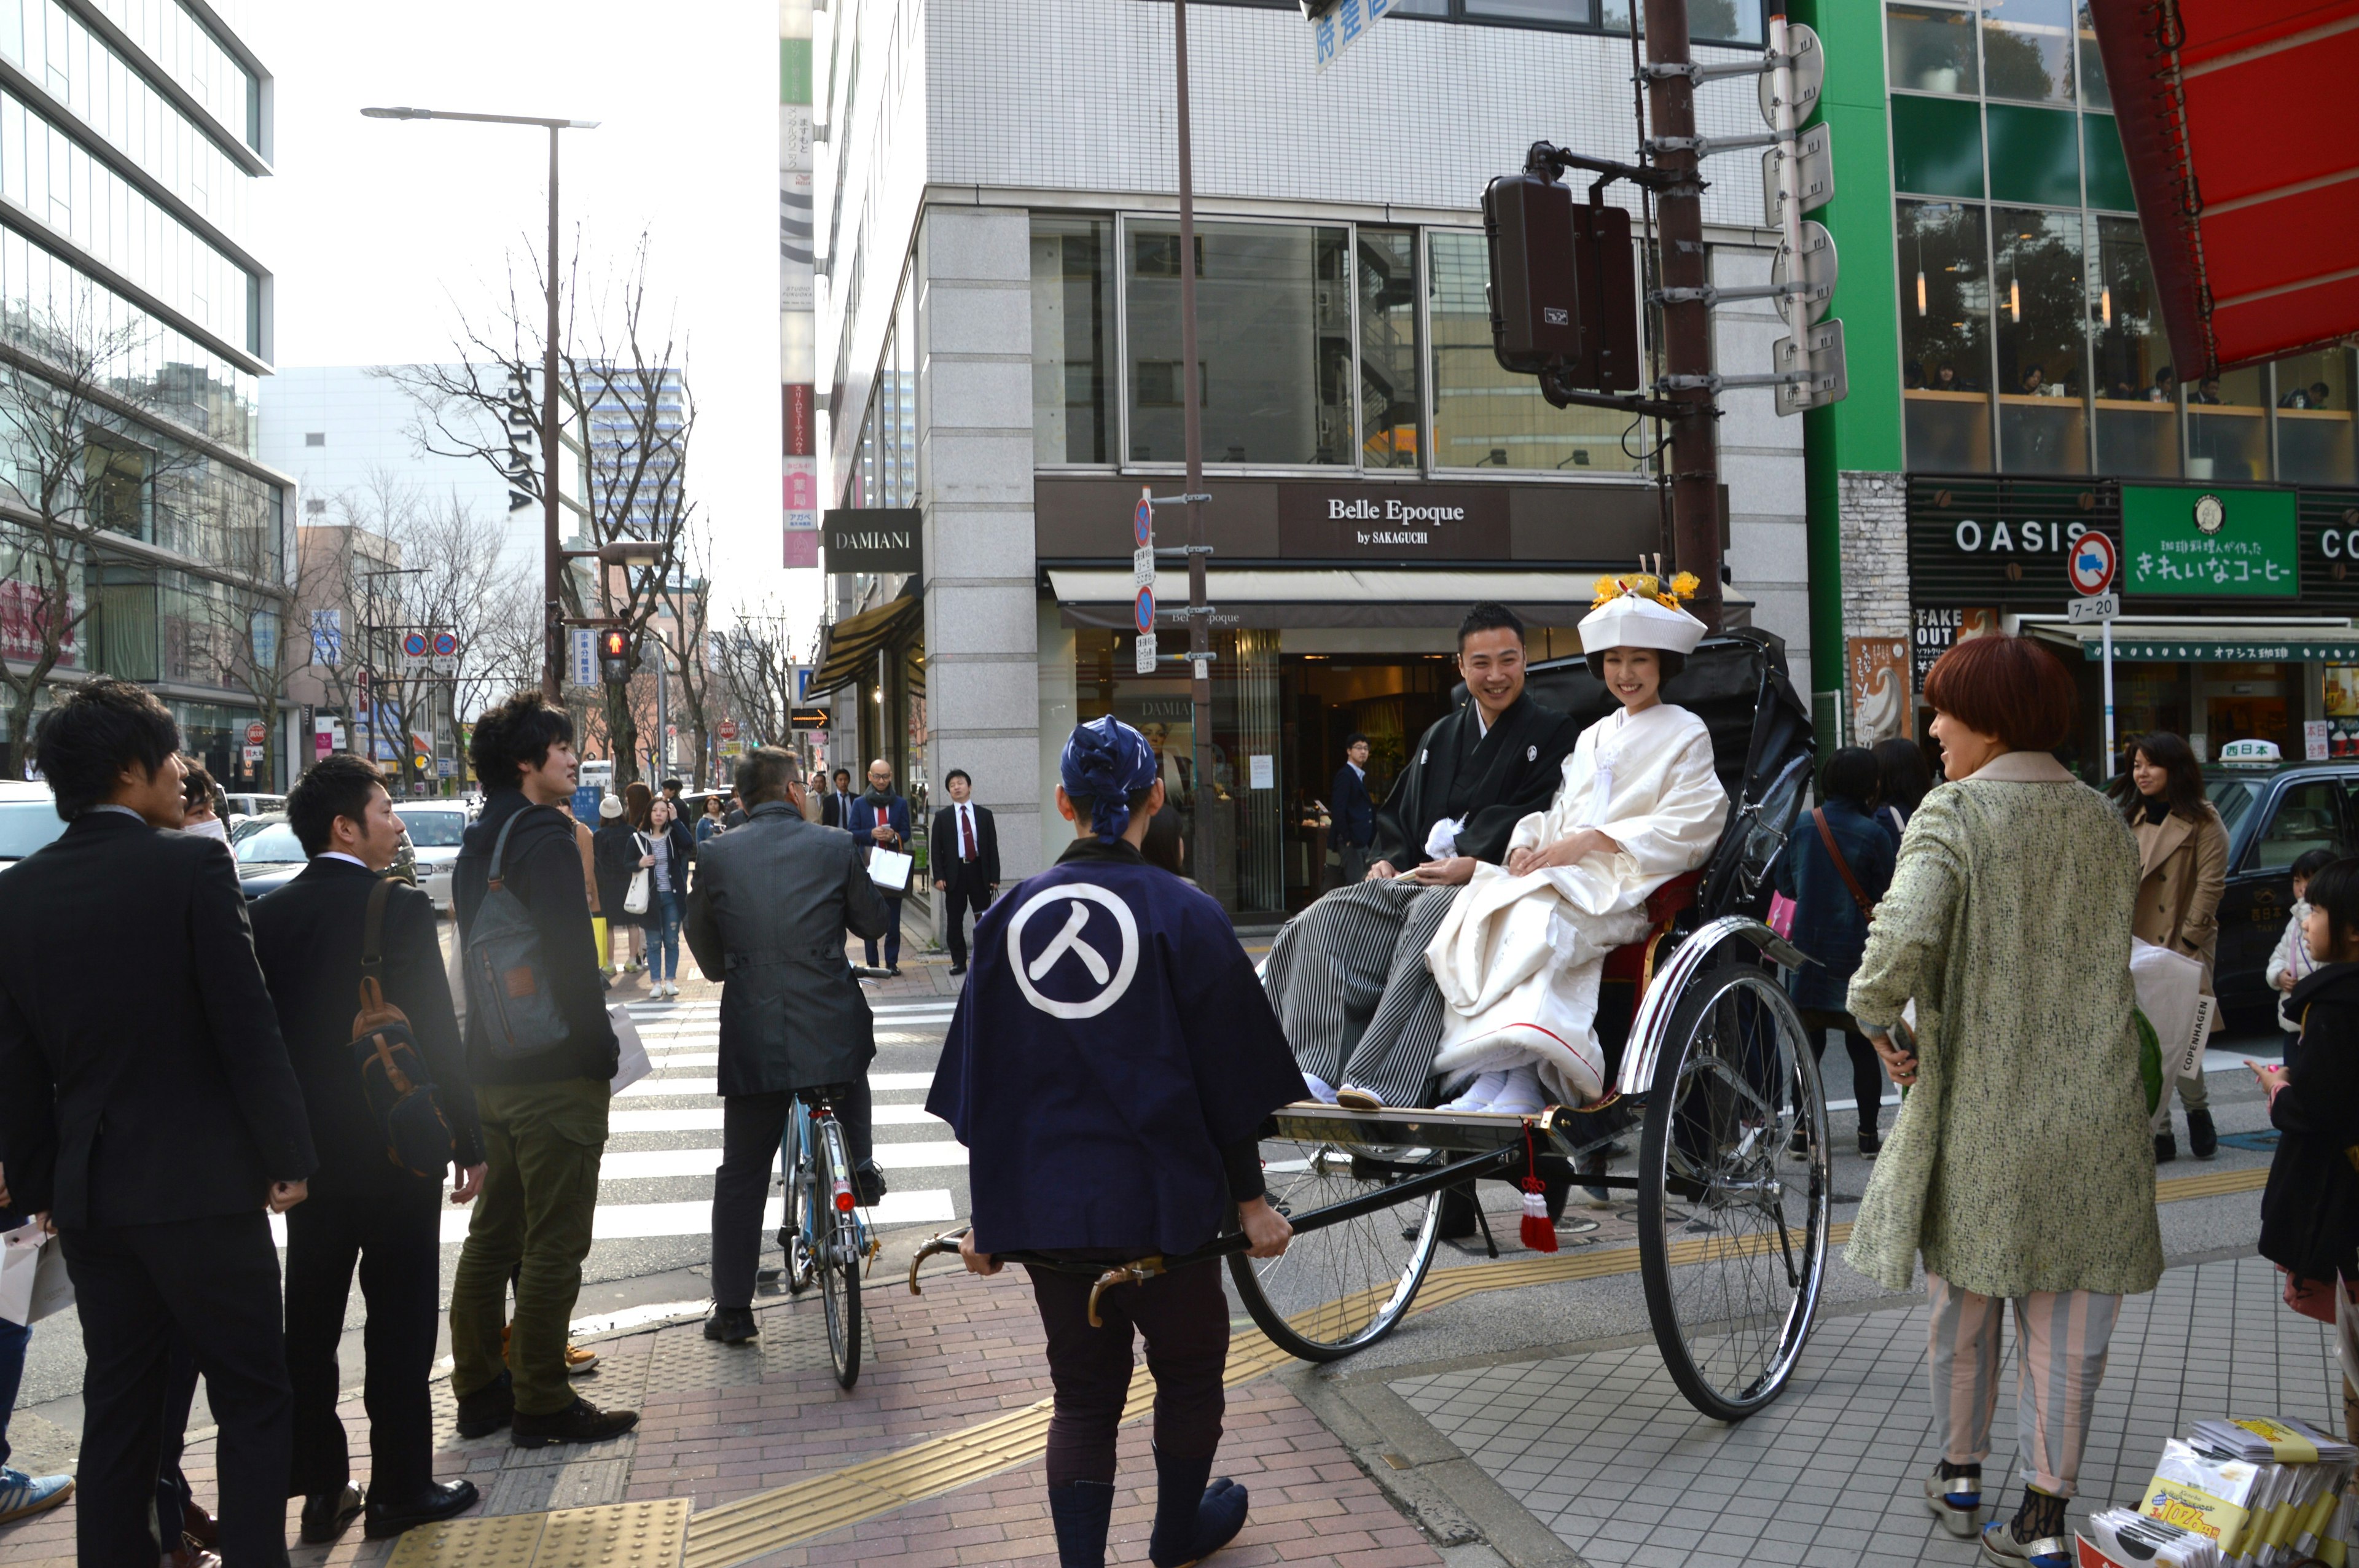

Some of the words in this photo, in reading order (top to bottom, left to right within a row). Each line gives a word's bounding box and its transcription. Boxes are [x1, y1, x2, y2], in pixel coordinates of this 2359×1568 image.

[508, 367, 532, 512] TSUTAYA
[794, 478, 806, 507] 薬局
[1328, 499, 1380, 520] Belle
[1385, 500, 1464, 526] Epoque
[836, 532, 910, 548] DAMIANI
[1357, 531, 1370, 545] by
[1372, 532, 1428, 544] SAKAGUCHI
[1956, 520, 2087, 552] OASIS
[2161, 539, 2261, 555] 珈琲料理人が作った
[2137, 552, 2290, 583] きれいなコーヒー
[2075, 600, 2111, 617] 7-20
[1207, 615, 1239, 625] poque
[1916, 609, 1962, 626] TAKE
[1917, 628, 1951, 645] OUT
[581, 633, 589, 683] 歩車分離信号
[2215, 647, 2288, 658] オアシス珈琲
[2307, 725, 2326, 736] 本日
[2226, 744, 2268, 756] 西日本
[2308, 744, 2326, 757] 全席
[2183, 1001, 2207, 1071] COPENHAGEN
